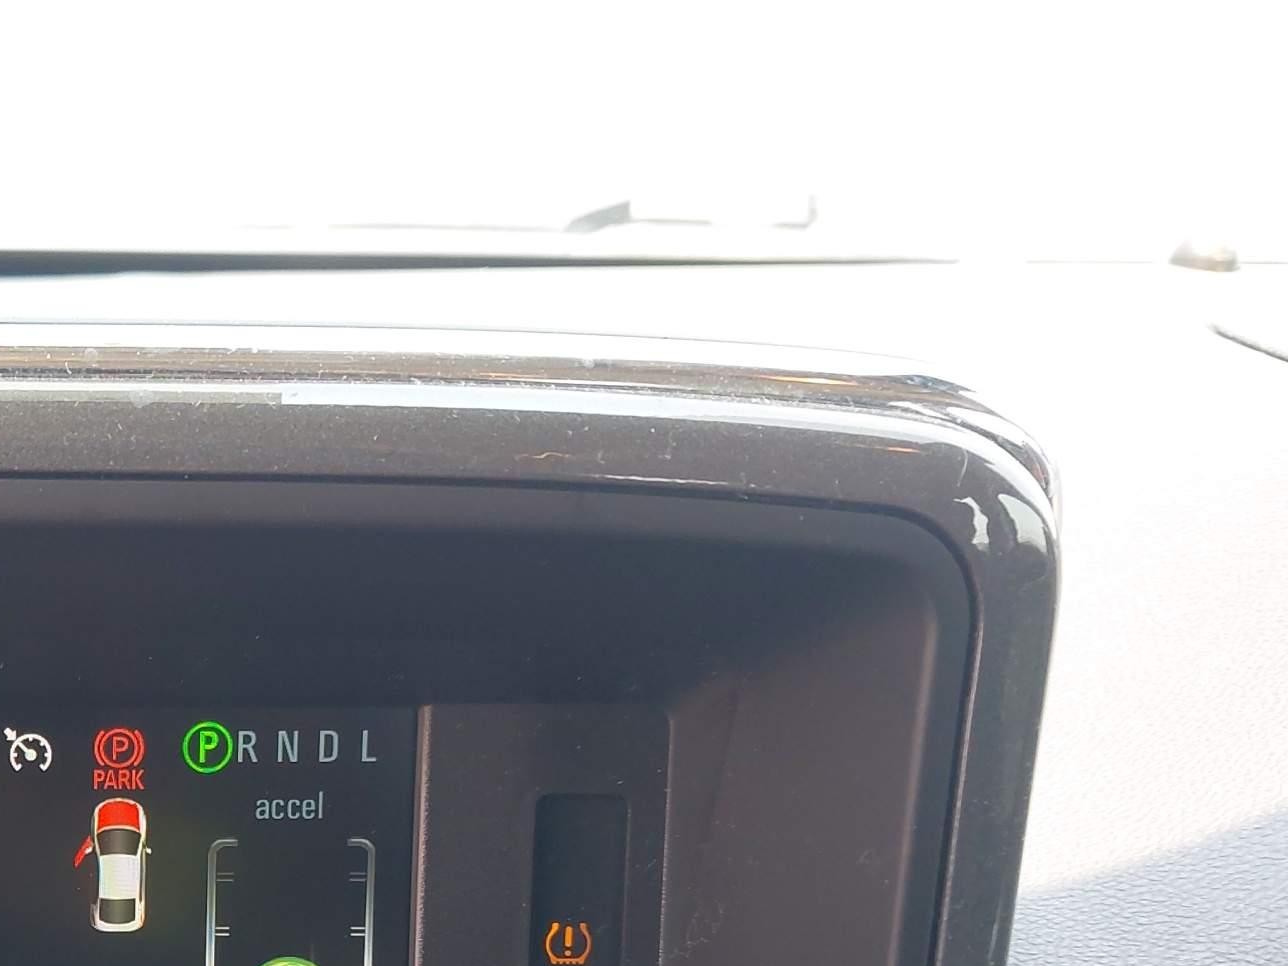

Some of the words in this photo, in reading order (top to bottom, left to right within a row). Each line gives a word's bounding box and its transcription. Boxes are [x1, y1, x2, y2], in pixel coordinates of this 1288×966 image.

[112, 738, 129, 760] P
[199, 730, 217, 762] P
[238, 730, 257, 763] R
[277, 730, 298, 763] N
[319, 730, 339, 763] D
[361, 730, 376, 763] L
[93, 769, 144, 790] PARK
[255, 792, 324, 819] accel
